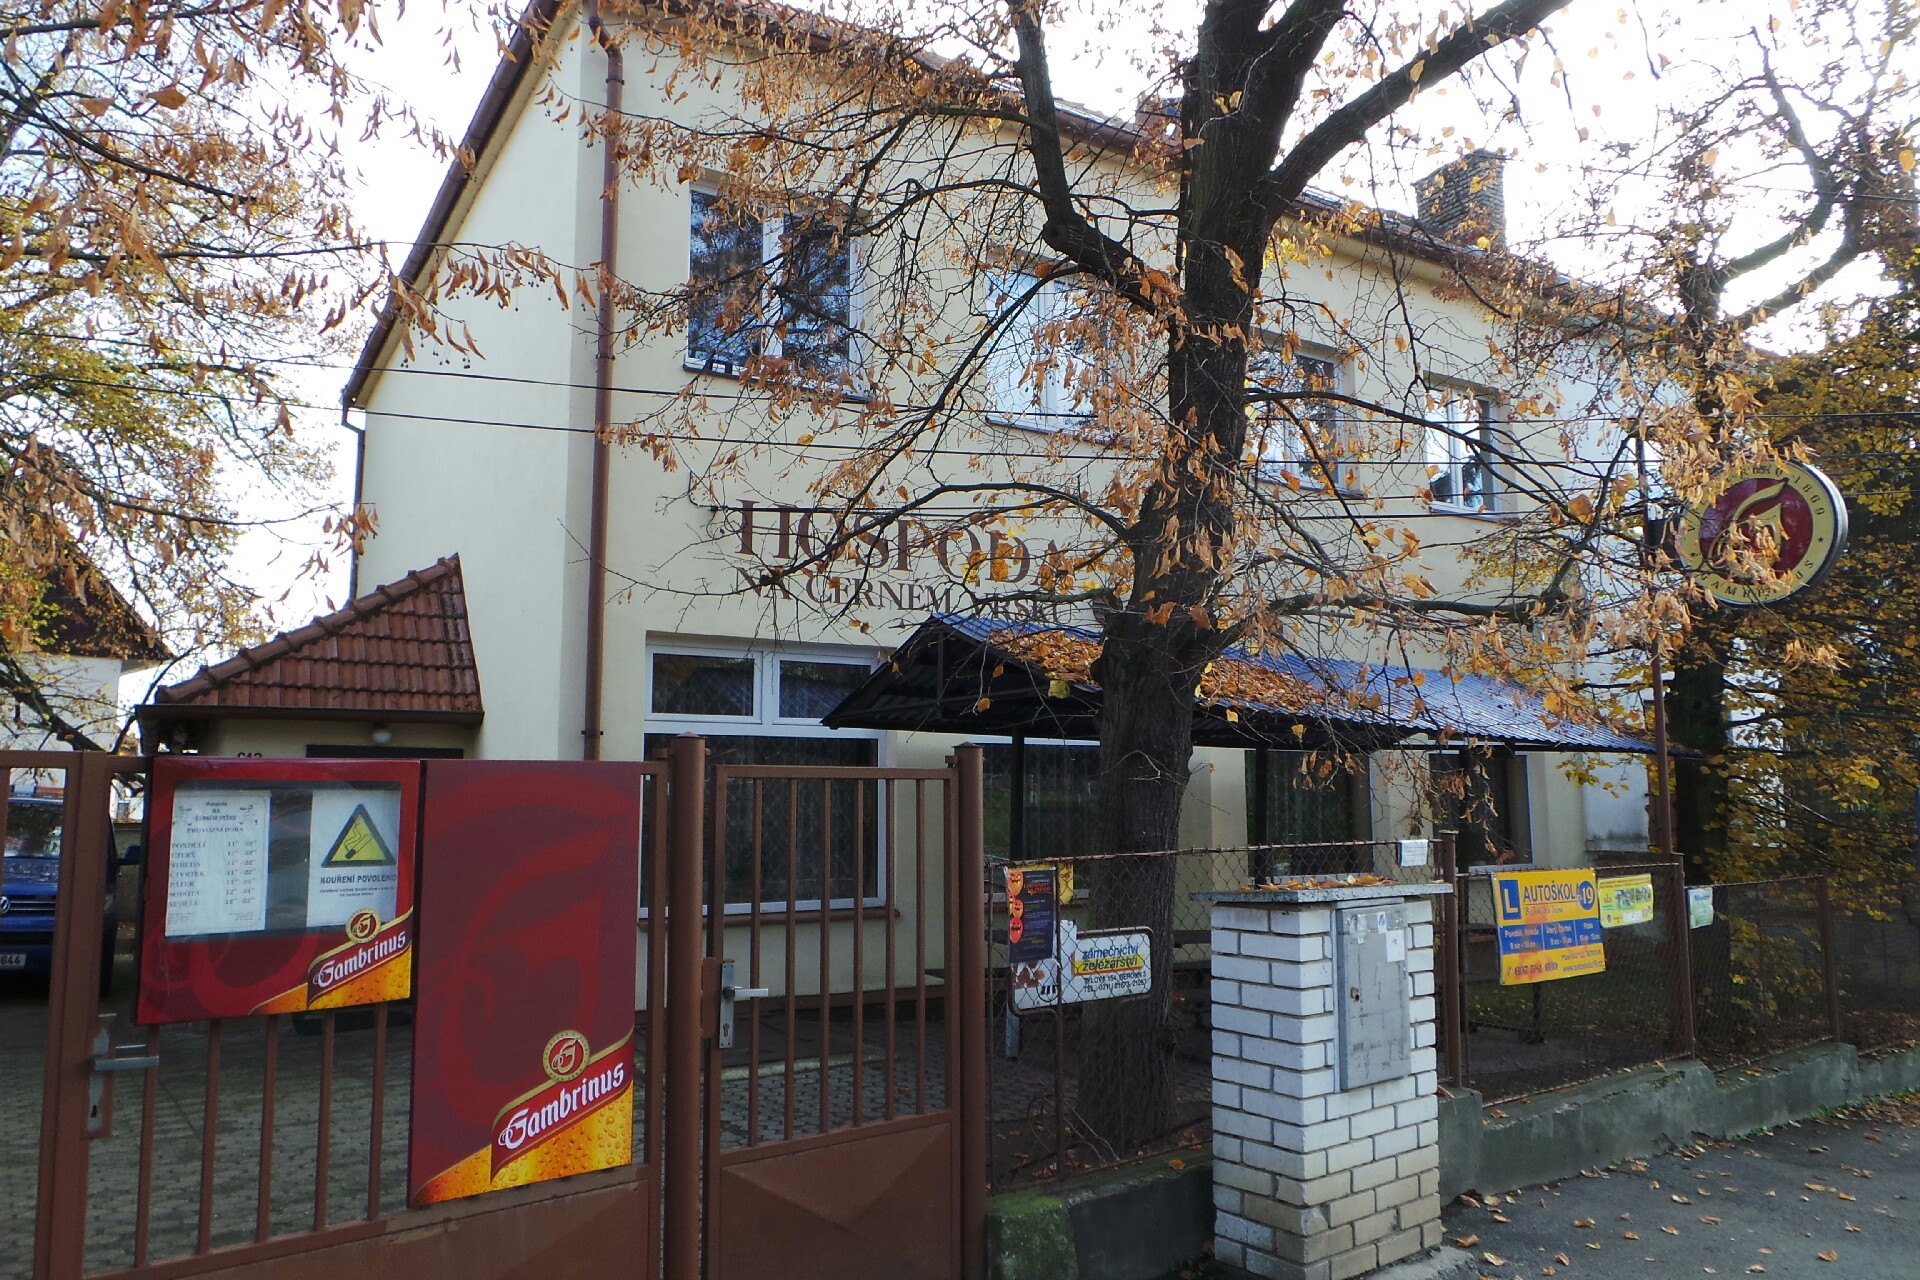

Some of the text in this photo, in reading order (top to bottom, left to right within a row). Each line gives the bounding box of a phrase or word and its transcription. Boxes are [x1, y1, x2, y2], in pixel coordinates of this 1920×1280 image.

[1699, 559, 1814, 599] GAMBRUS
[320, 874, 397, 885] KOUŘENÍ POVOLENO
[1582, 887, 1592, 904] 19
[312, 931, 406, 988] Gambrinus
[1082, 943, 1139, 960] zámečnictví
[1083, 955, 1138, 971] železářství
[498, 1062, 624, 1149] Gambrinus
